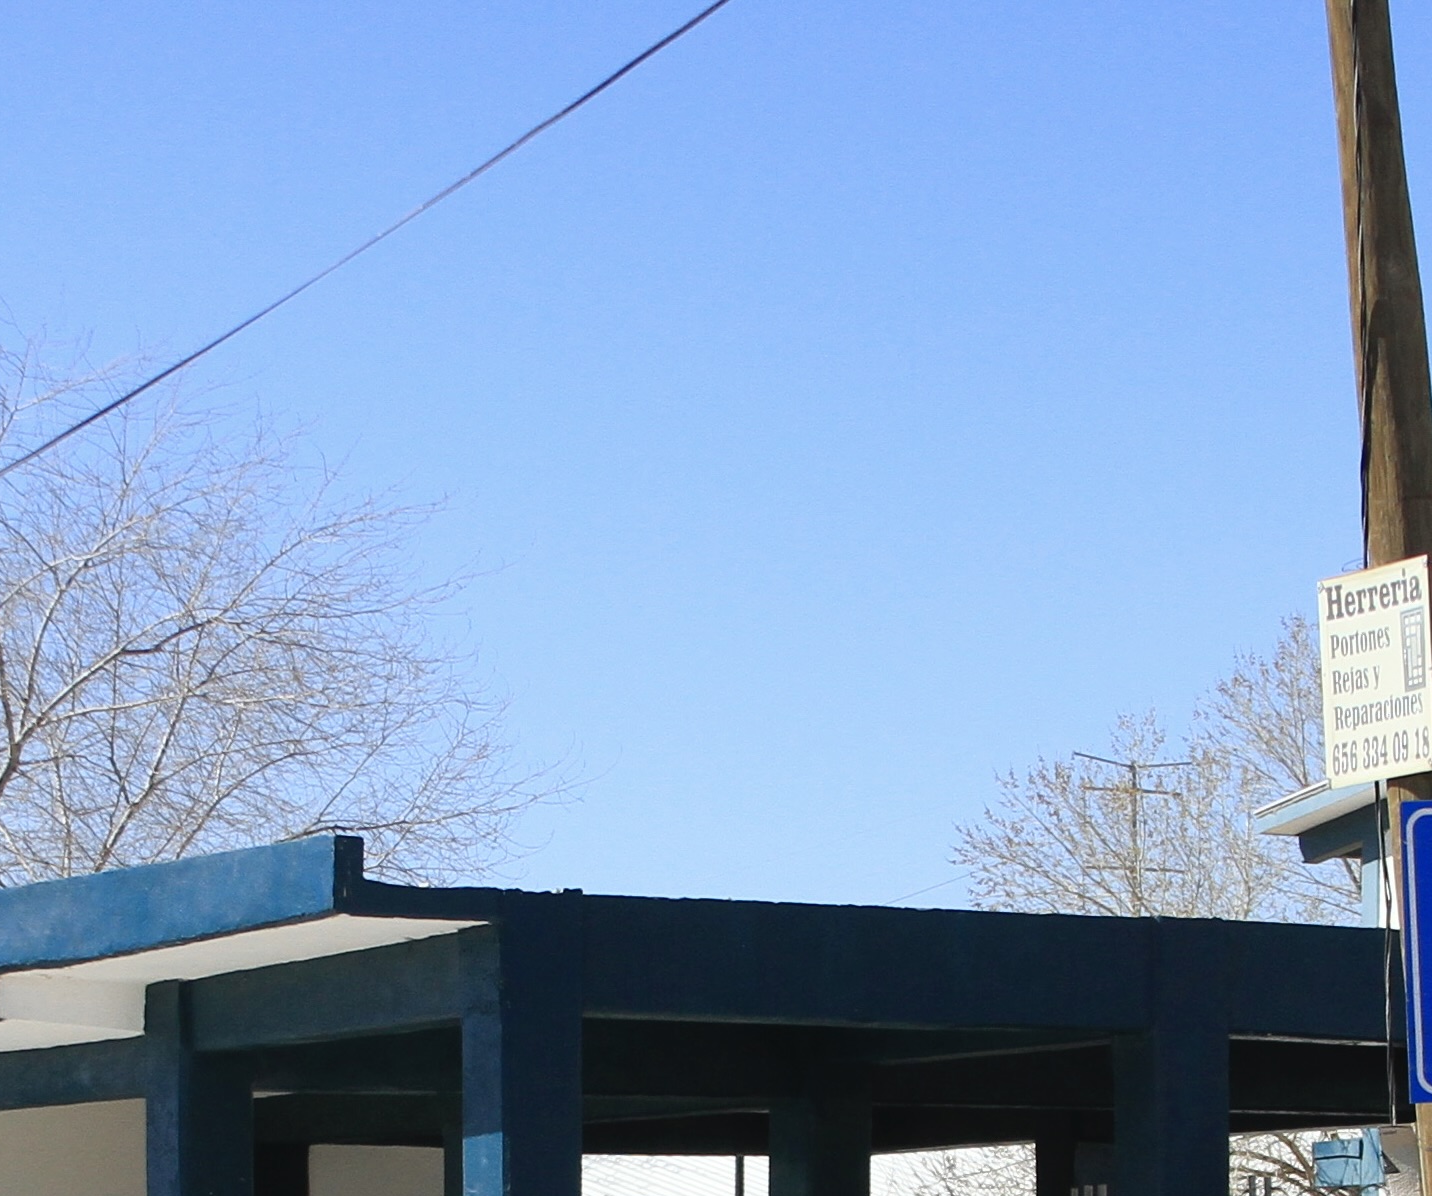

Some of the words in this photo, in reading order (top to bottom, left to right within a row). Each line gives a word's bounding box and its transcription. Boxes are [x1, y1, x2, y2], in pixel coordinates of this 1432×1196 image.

[1330, 627, 1390, 659] Portones
[1332, 667, 1369, 695] Rejas
[1372, 664, 1381, 690] y
[1334, 691, 1423, 731] Reparaciones
[1332, 739, 1358, 776] 656
[1362, 734, 1388, 770] 334
[1392, 729, 1408, 764] 09
[1414, 726, 1430, 760] 18
